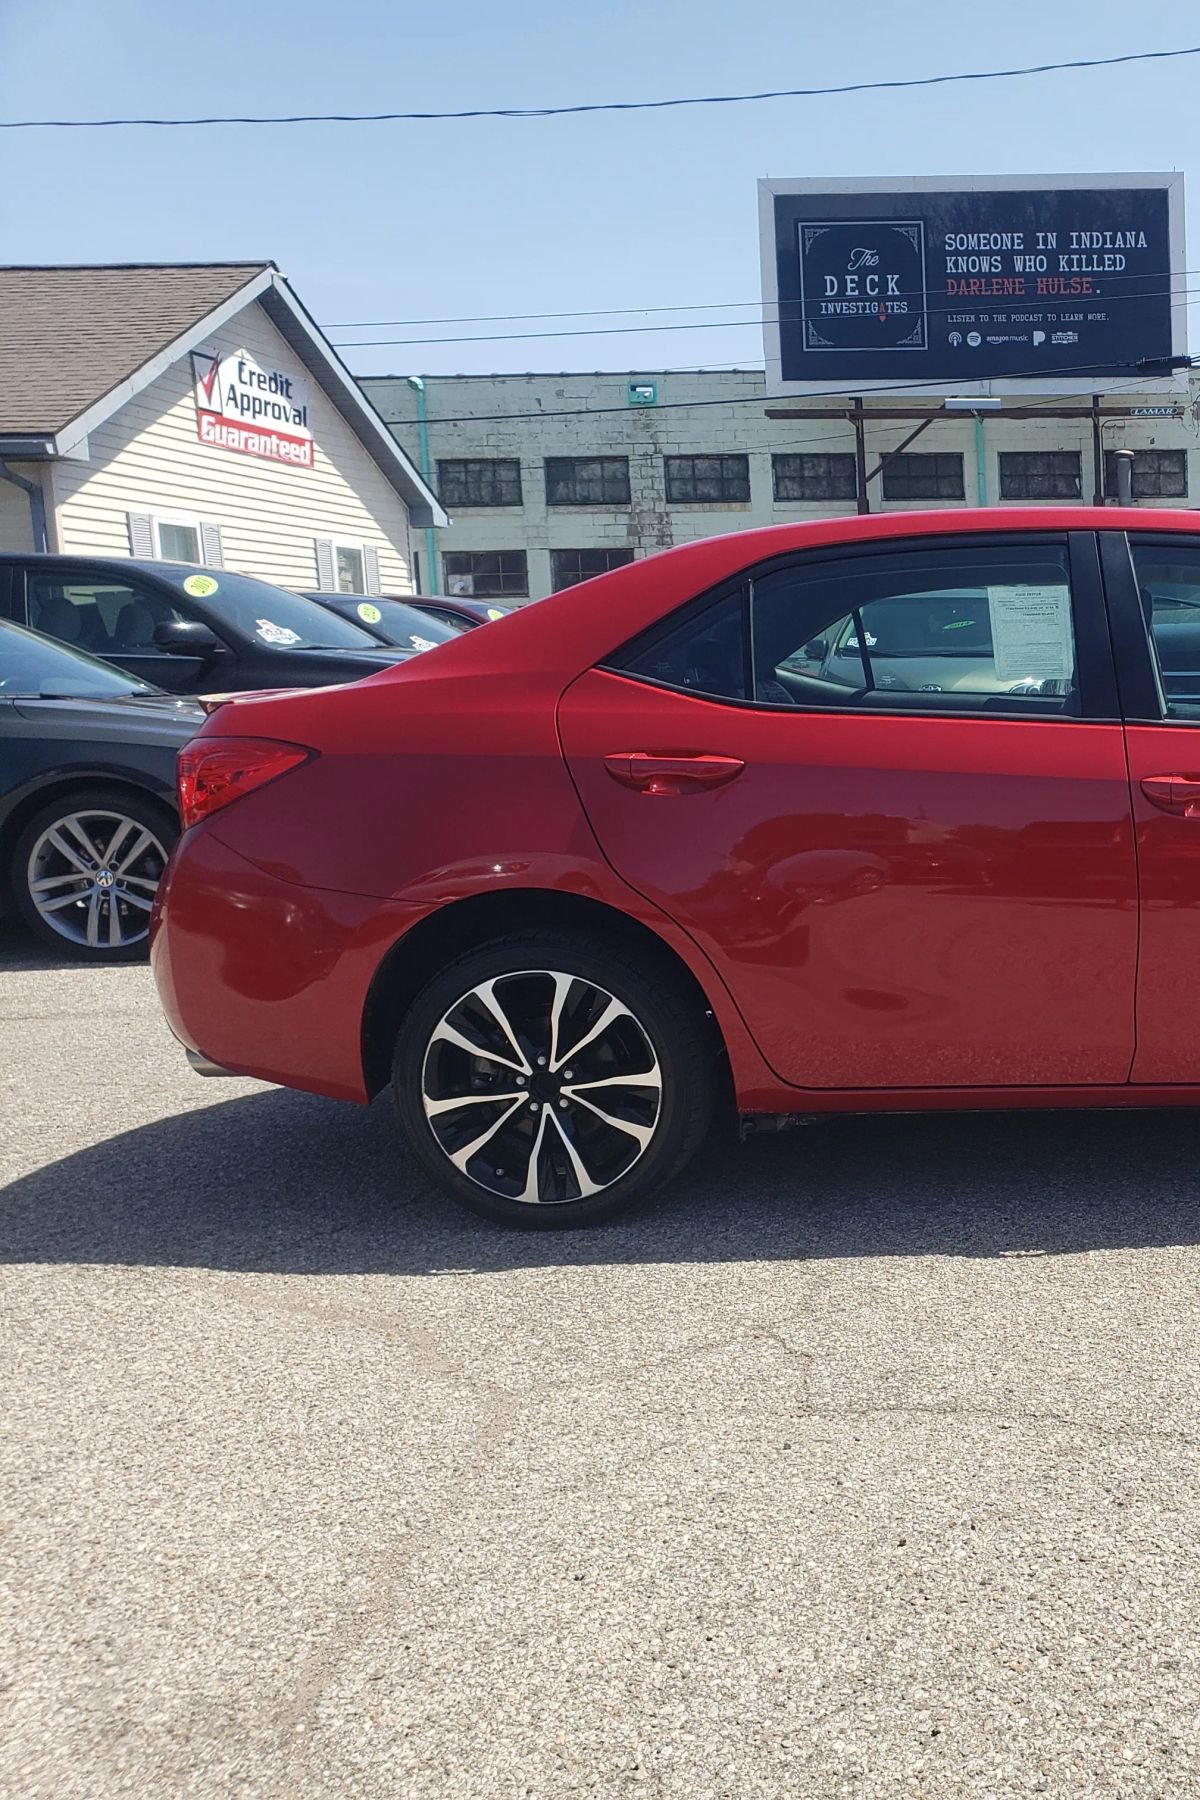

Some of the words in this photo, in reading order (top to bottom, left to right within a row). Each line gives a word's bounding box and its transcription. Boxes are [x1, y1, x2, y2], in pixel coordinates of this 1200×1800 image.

[945, 233, 1024, 250] SOMEONE
[1036, 232, 1057, 249] IN
[1070, 231, 1148, 249] INDIANA
[848, 247, 879, 271] The
[946, 256, 1002, 273] KNOWS
[1013, 255, 1047, 272] WHO
[1059, 254, 1126, 271] KILLED
[824, 274, 900, 296] DECK
[946, 278, 1025, 296] DARLENE
[1036, 277, 1101, 294] HULSE.
[820, 301, 908, 314] INVESTIGATES
[992, 314, 1007, 322] THE
[1010, 314, 1043, 322] PODCAST
[1061, 313, 1084, 321] LEARN
[1087, 313, 1110, 321] MORE.
[238, 360, 293, 399] Credit
[226, 383, 308, 427] Approval
[201, 414, 312, 466] Guaranteed
